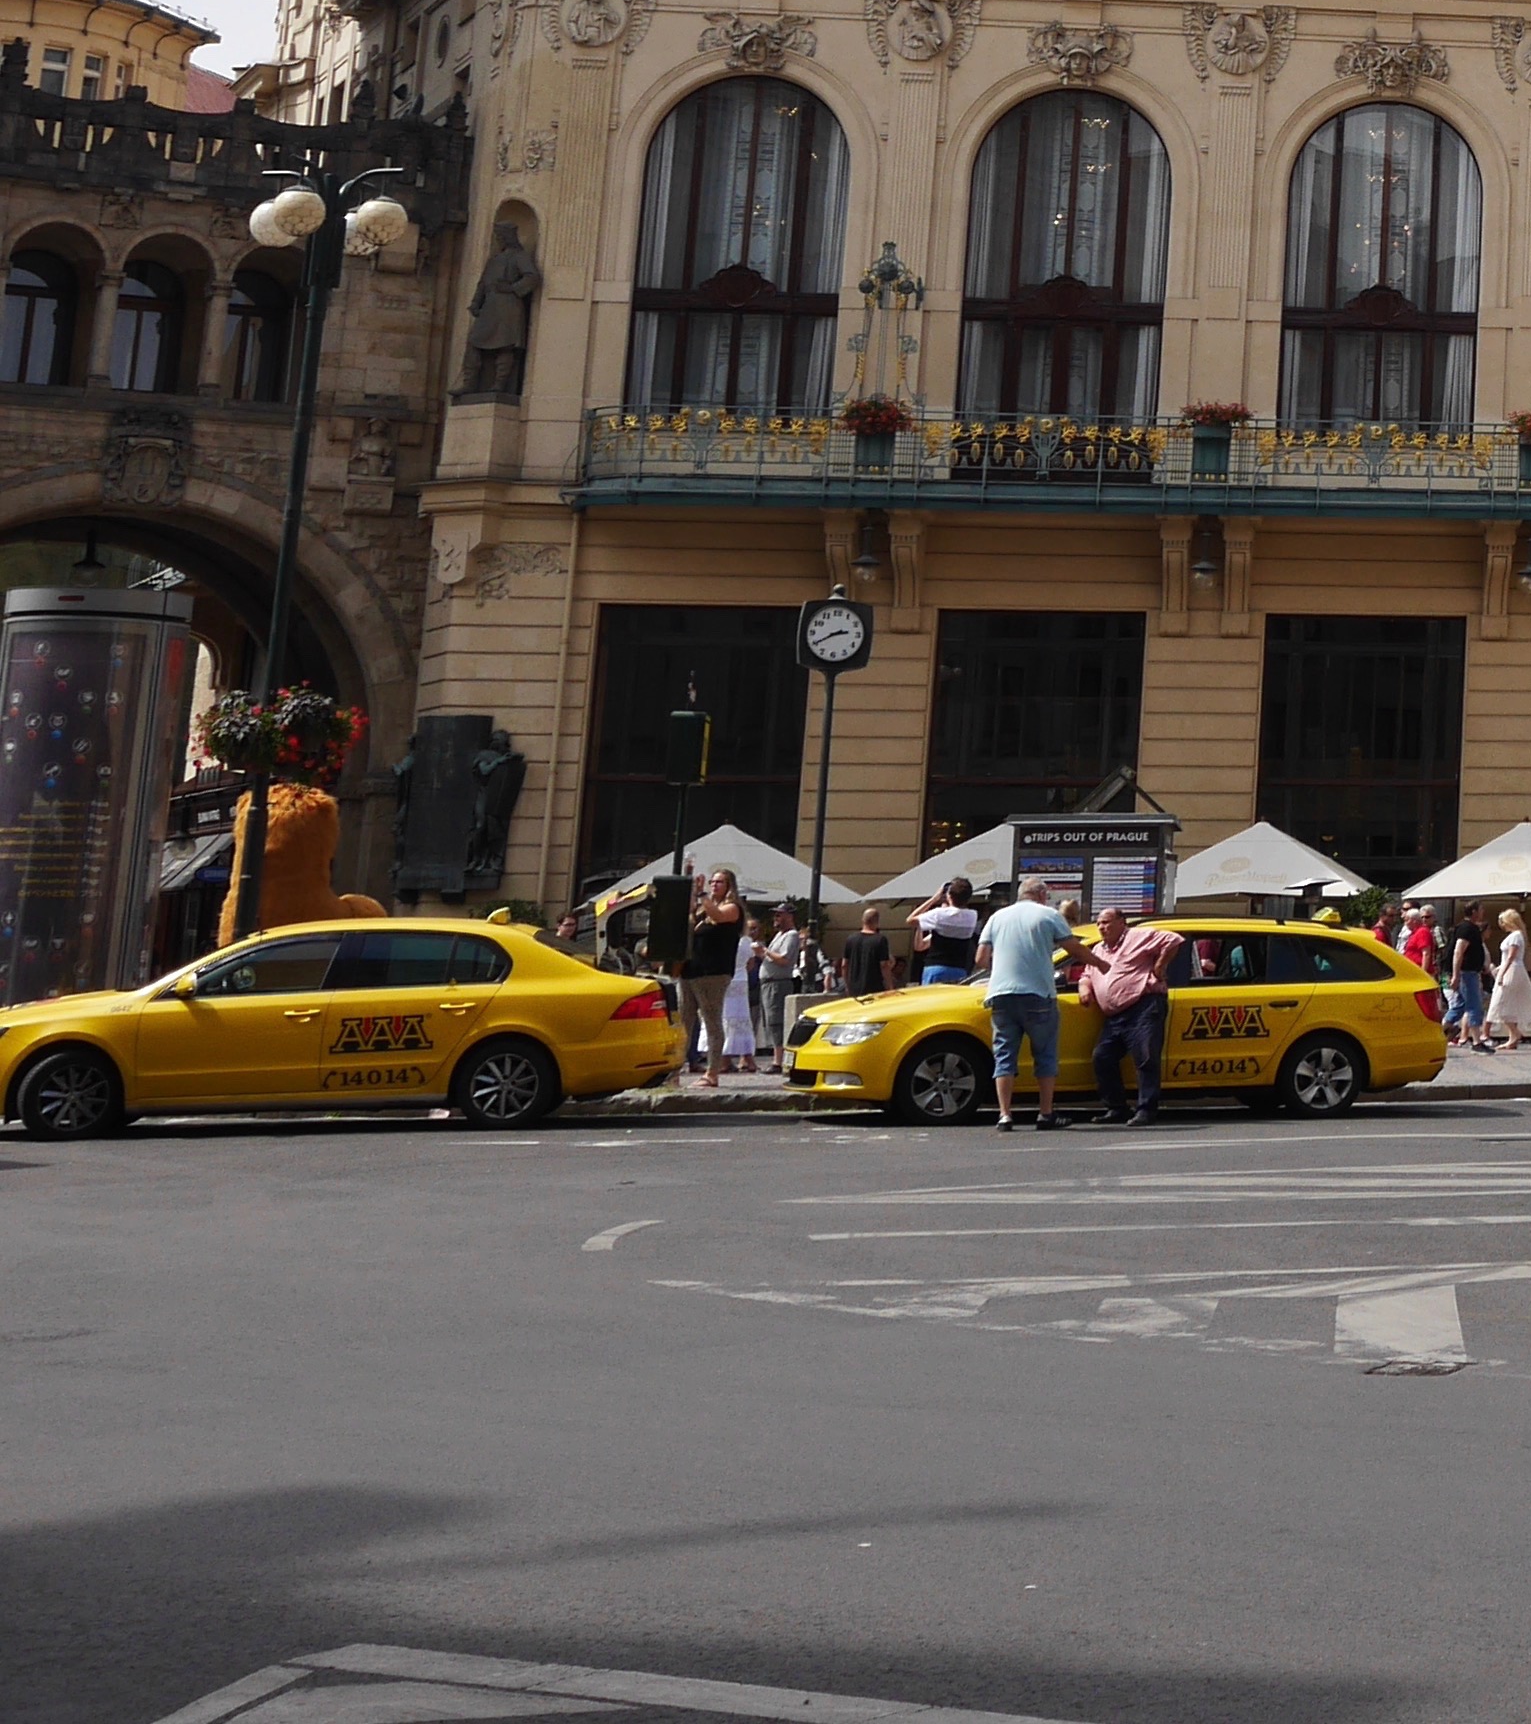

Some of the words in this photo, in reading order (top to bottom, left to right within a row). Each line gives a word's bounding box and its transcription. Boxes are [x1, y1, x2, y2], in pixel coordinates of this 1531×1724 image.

[833, 609, 843, 617] 12
[1063, 832, 1086, 841] OUT
[1089, 832, 1103, 841] OF
[1106, 832, 1149, 842] PRAGUE
